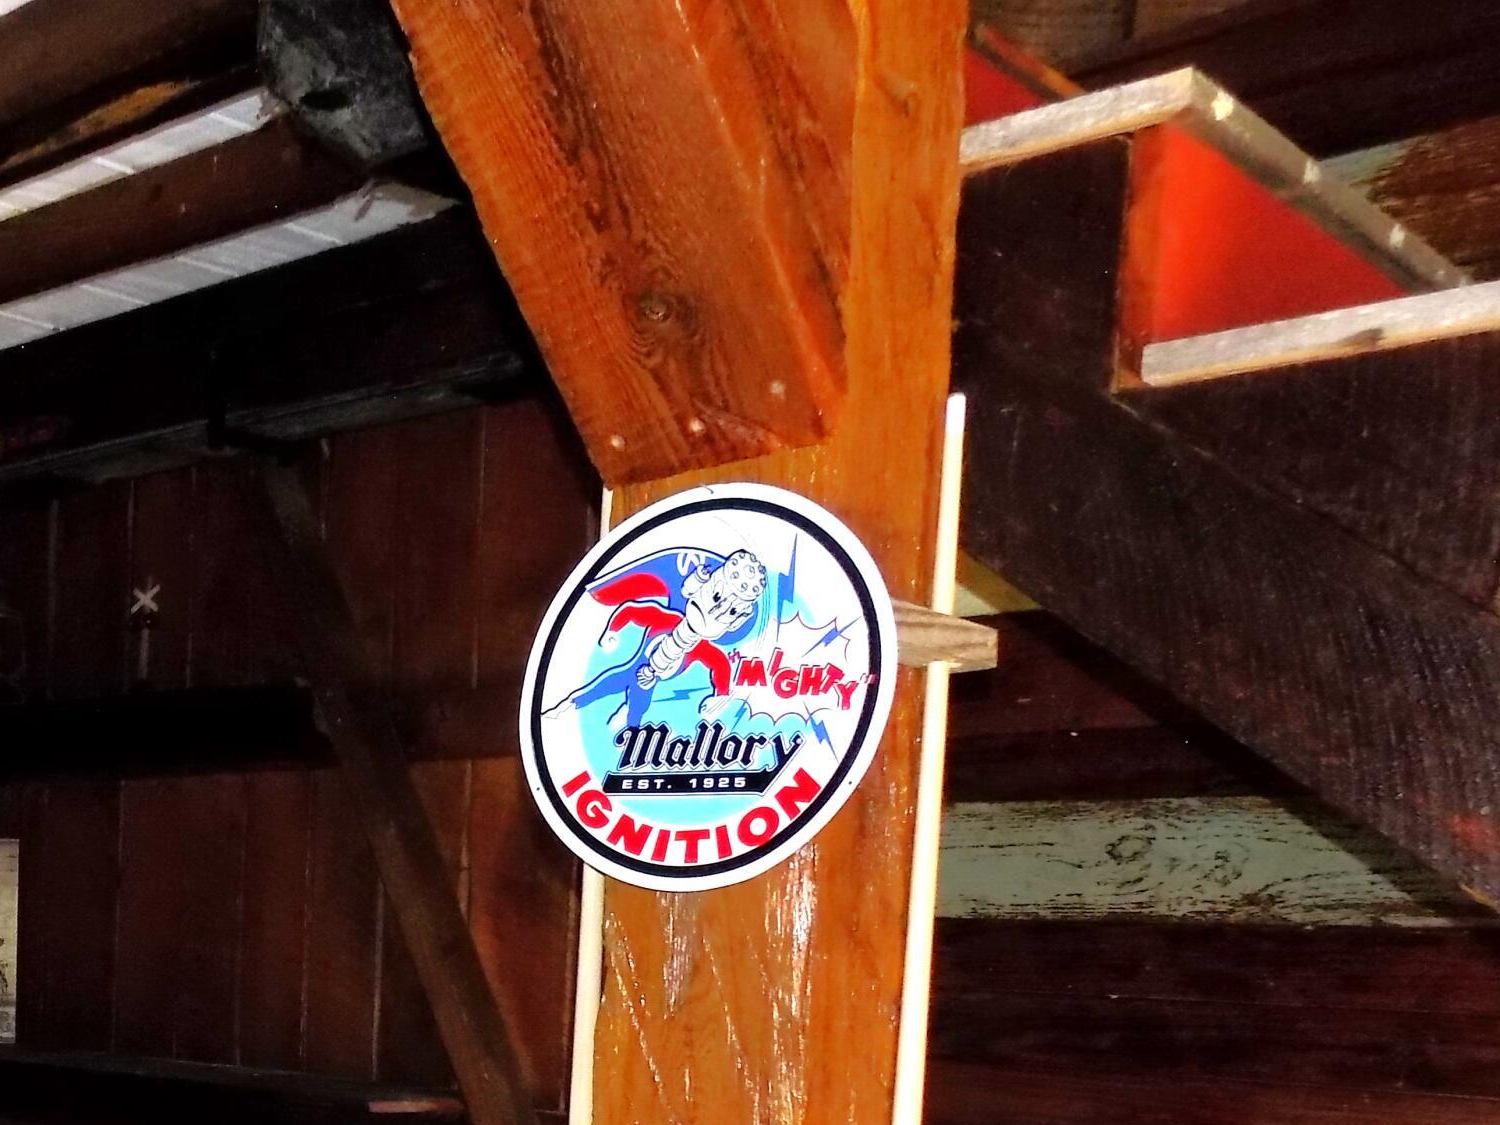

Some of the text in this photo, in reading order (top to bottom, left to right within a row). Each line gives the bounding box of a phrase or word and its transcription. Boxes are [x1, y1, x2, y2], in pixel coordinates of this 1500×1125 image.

[615, 719, 803, 771] Mallory
[621, 776, 747, 790] EST. 1925
[561, 767, 822, 864] IGNITION
